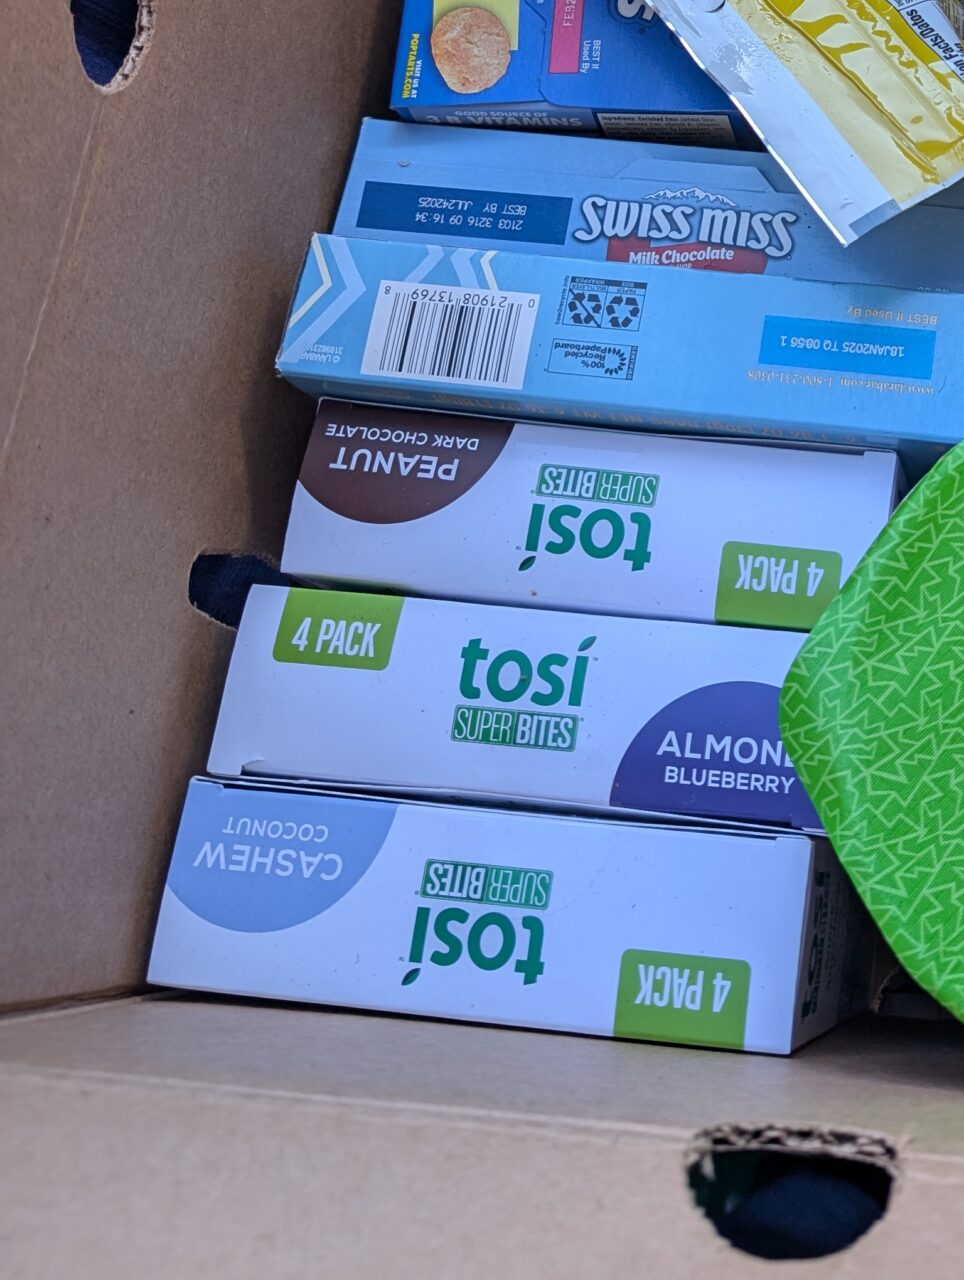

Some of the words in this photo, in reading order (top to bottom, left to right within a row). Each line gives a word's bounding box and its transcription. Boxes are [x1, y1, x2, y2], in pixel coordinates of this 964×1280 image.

[582, 40, 591, 61] Used
[592, 40, 601, 62] BEST
[402, 33, 420, 99] POPTARTS.COM
[414, 60, 422, 77] VISIT
[580, 62, 590, 74] By
[412, 78, 420, 89] US
[411, 89, 419, 99] AT
[454, 111, 488, 119] GOOD
[490, 111, 529, 120] SOURCE
[531, 112, 548, 121] OF
[463, 113, 583, 129] VITAMINS
[418, 197, 474, 211] JUL242025
[482, 202, 498, 214] BY
[502, 204, 528, 216] BEST
[415, 211, 445, 225] 16:34
[450, 215, 464, 227] 09
[468, 217, 493, 230] 3216
[499, 219, 524, 231] 2103
[574, 195, 694, 242] SWISS
[629, 251, 659, 266] Milk
[661, 246, 734, 265] Chocolate
[575, 277, 606, 285] WRAPPER
[384, 285, 392, 297] 8
[410, 288, 452, 302] 13769
[462, 291, 510, 308] 21908
[528, 297, 537, 311] 0
[847, 305, 862, 318] By
[864, 308, 894, 320] Used
[908, 313, 938, 326] BEST
[554, 342, 608, 354] Paperboard
[780, 335, 788, 347] 1
[823, 340, 839, 352] TQ
[842, 341, 905, 358] 18JAN2025
[564, 350, 607, 361] Recycled
[581, 360, 606, 369] 100%
[840, 376, 935, 395] www.larabar.com
[325, 422, 430, 446] CHOCOLATE
[431, 433, 480, 451] DARK
[329, 445, 460, 482] PEANUT
[541, 466, 597, 499] BITES
[602, 474, 656, 506] SUPER
[734, 553, 799, 596] PACK
[805, 560, 825, 597] 4
[290, 616, 312, 651] 4
[315, 619, 382, 658] PACK
[454, 707, 511, 744] SUPER
[516, 713, 577, 749] BITES
[656, 730, 794, 768] ALMON
[664, 765, 796, 796] BLUEBERRY
[222, 816, 329, 843] COCONUT
[192, 839, 344, 882] CASHEW
[423, 861, 485, 901] BITES
[489, 867, 551, 906] SUPER
[637, 962, 705, 1011] PACK
[711, 970, 733, 1013] 4
